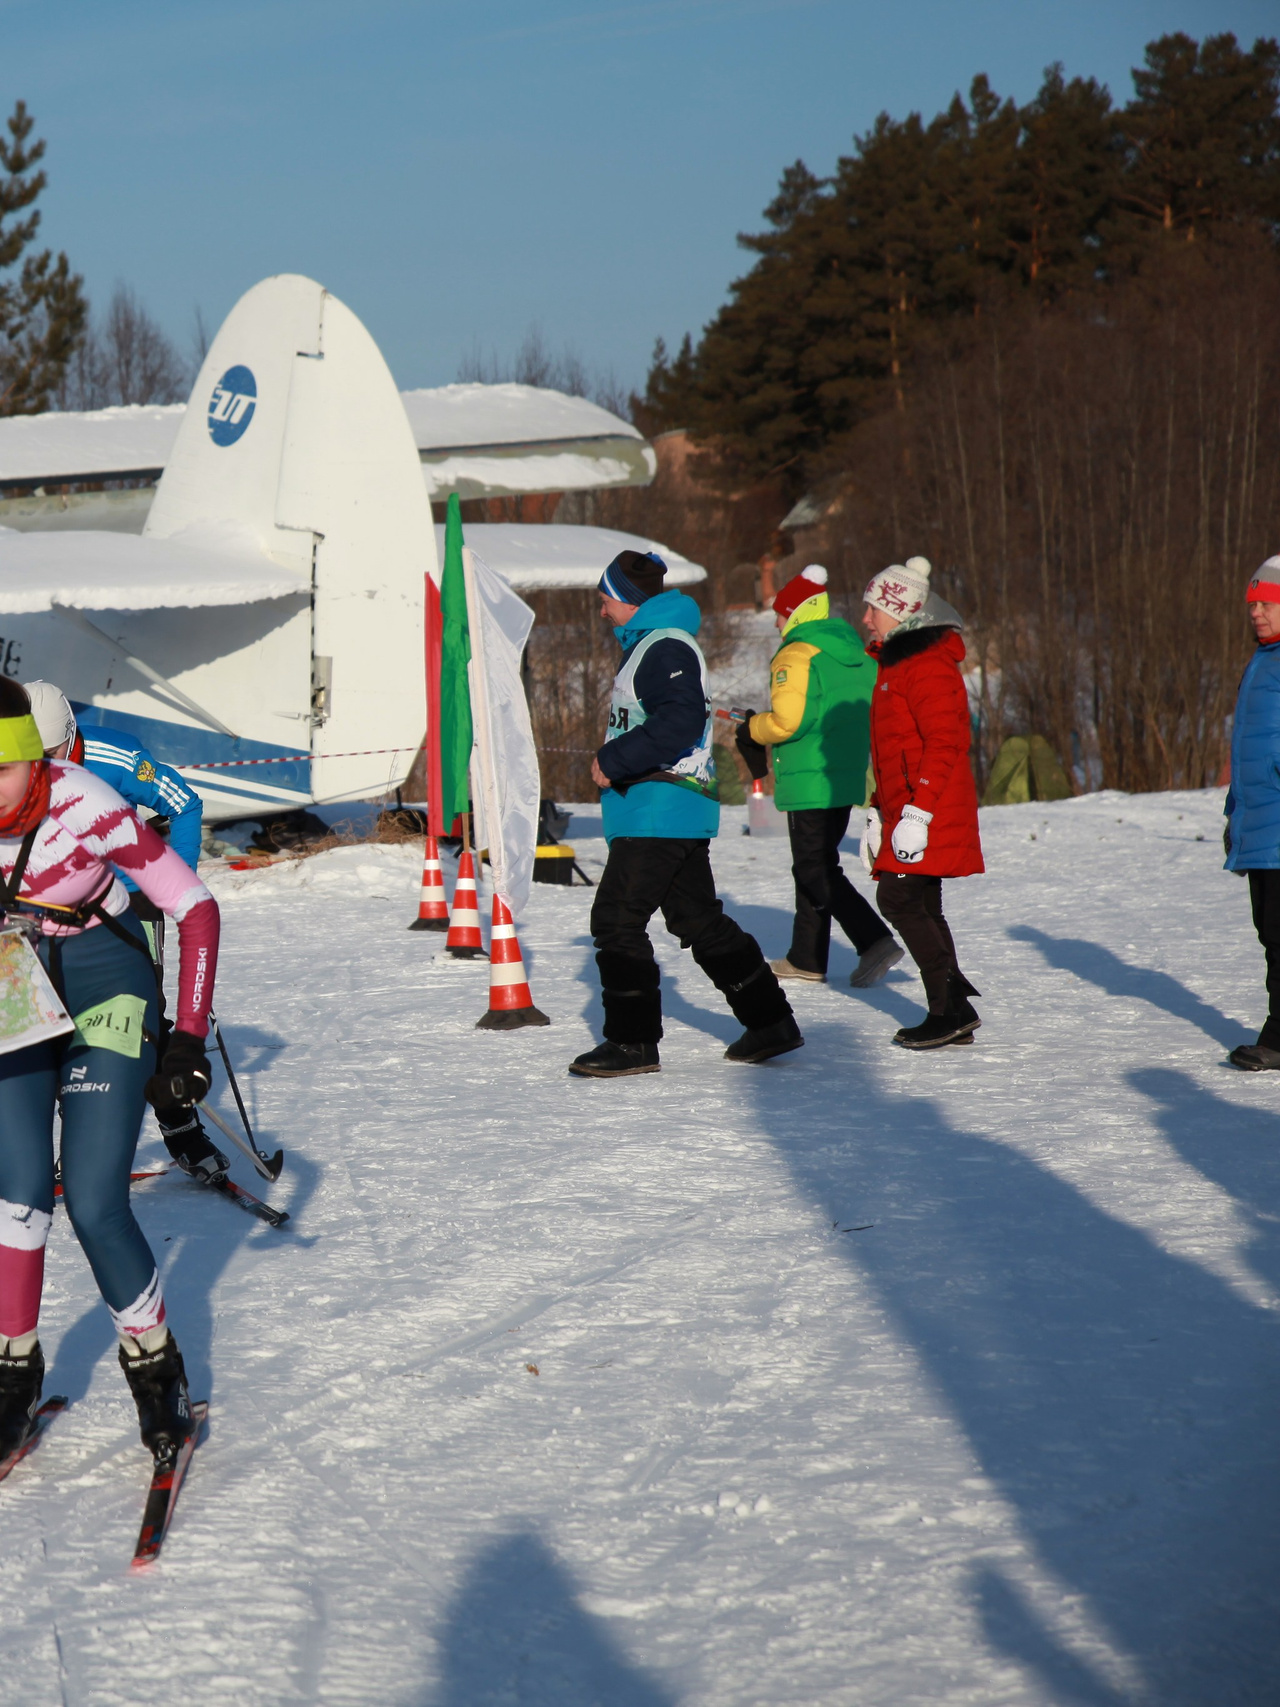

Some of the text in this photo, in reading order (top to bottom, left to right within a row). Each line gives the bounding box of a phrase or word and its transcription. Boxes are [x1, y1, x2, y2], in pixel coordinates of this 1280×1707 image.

[192, 947, 208, 1013] NORDSKI
[60, 1082, 111, 1095] ORDSKI
[127, 1351, 166, 1369] SPINE
